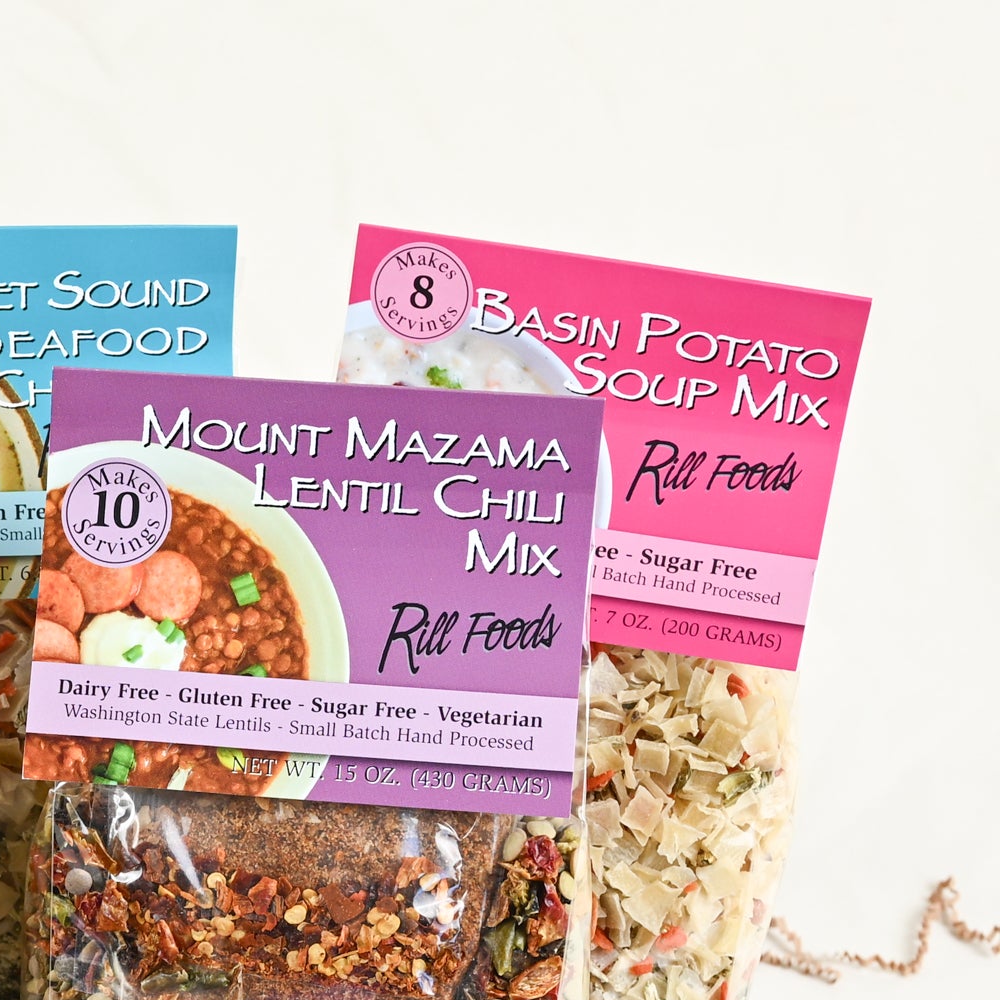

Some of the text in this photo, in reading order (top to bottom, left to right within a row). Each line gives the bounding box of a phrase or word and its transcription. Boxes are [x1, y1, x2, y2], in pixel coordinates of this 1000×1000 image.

[396, 251, 457, 280] Makes
[47, 271, 210, 310] SOUND
[410, 275, 434, 309] 8
[380, 296, 458, 332] Servings
[471, 287, 840, 381] BASIN POTATO
[564, 352, 831, 429] SOUP MIX
[140, 403, 571, 472] MOUNT MAZAMA
[87, 468, 158, 503] Makes
[626, 439, 802, 505] Rill Foods
[15, 504, 45, 520] Fre
[91, 490, 140, 529] 10
[253, 462, 565, 524] LENTIL CHILI
[0, 527, 42, 541] Small
[73, 518, 160, 555] Servings
[465, 528, 562, 578] MIX
[640, 548, 703, 573] Sugar
[710, 558, 758, 580] Free
[602, 567, 647, 586] Batch
[653, 575, 696, 593] Hand
[702, 582, 781, 606] Processed
[378, 602, 562, 674] Rill Foods
[606, 610, 617, 624] 7
[622, 612, 653, 631] OZ.
[661, 618, 700, 638] (200
[706, 625, 782, 652] GRAMS)
[57, 679, 111, 701] Dairy
[118, 681, 159, 701] Free
[178, 686, 245, 708] Gluten
[250, 692, 292, 711] Free
[311, 697, 368, 721] Sugar
[375, 699, 417, 719] Free
[437, 706, 544, 732] Vegetarian
[64, 703, 162, 726] Washington
[168, 709, 209, 728] State
[215, 712, 272, 733] Lentils
[289, 717, 337, 738] Small
[342, 721, 391, 742] Batch
[397, 725, 444, 745] Hand
[449, 729, 534, 752] Processed
[231, 755, 552, 799] NET WT. 15 OZ. (430 GRAMS)
